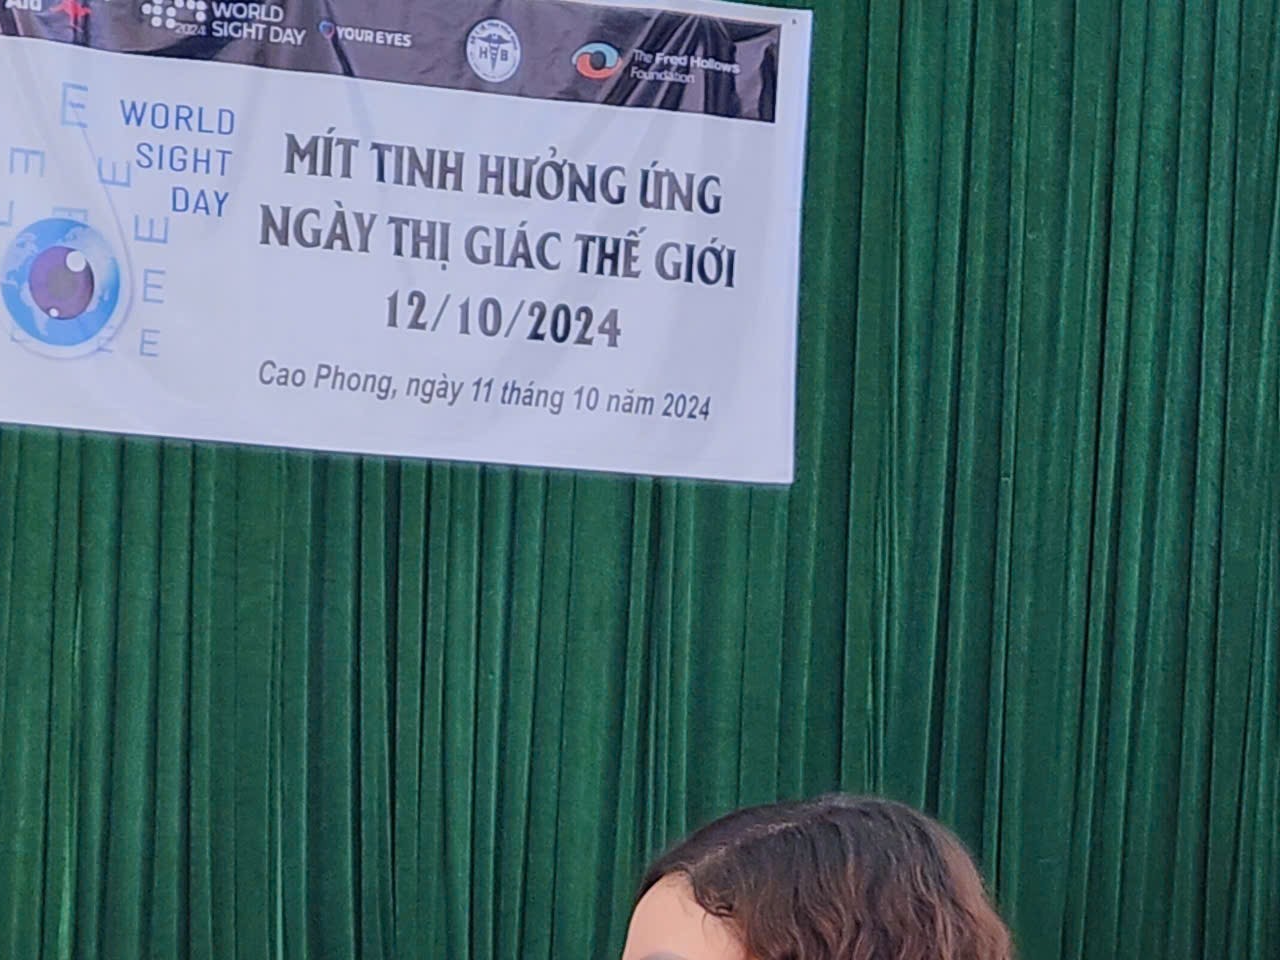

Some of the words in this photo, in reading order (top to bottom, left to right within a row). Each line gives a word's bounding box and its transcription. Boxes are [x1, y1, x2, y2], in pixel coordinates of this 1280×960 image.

[212, 2, 284, 23] WORLD
[211, 20, 267, 42] SIGHT
[269, 26, 306, 46] DAY
[336, 26, 374, 42] YOUR
[375, 30, 412, 47] EYES
[630, 66, 695, 84] Foundation
[631, 48, 654, 63] The
[654, 52, 688, 66] Fred
[689, 55, 741, 74] Hollows
[120, 99, 235, 136] WORLD
[136, 142, 233, 176] SIGHT
[284, 127, 360, 179] MÍT
[369, 142, 465, 192] TINH
[478, 146, 626, 205] HƯỞNG
[639, 160, 722, 215] ỨNG
[171, 186, 229, 217] DAY
[259, 200, 378, 253] NGÀY
[387, 215, 452, 271] THỊ
[464, 221, 562, 271] GIÁC
[574, 226, 647, 279] THẾ
[655, 237, 736, 288] GIỚI
[386, 289, 621, 348] 12/10/2024
[258, 360, 306, 388] Cao
[314, 363, 397, 401] Phong,
[406, 373, 464, 406] ngày
[472, 376, 494, 403] 11
[500, 379, 565, 415] tháng
[573, 385, 599, 411] 10
[606, 388, 655, 416] năm
[662, 392, 711, 421] 2024
